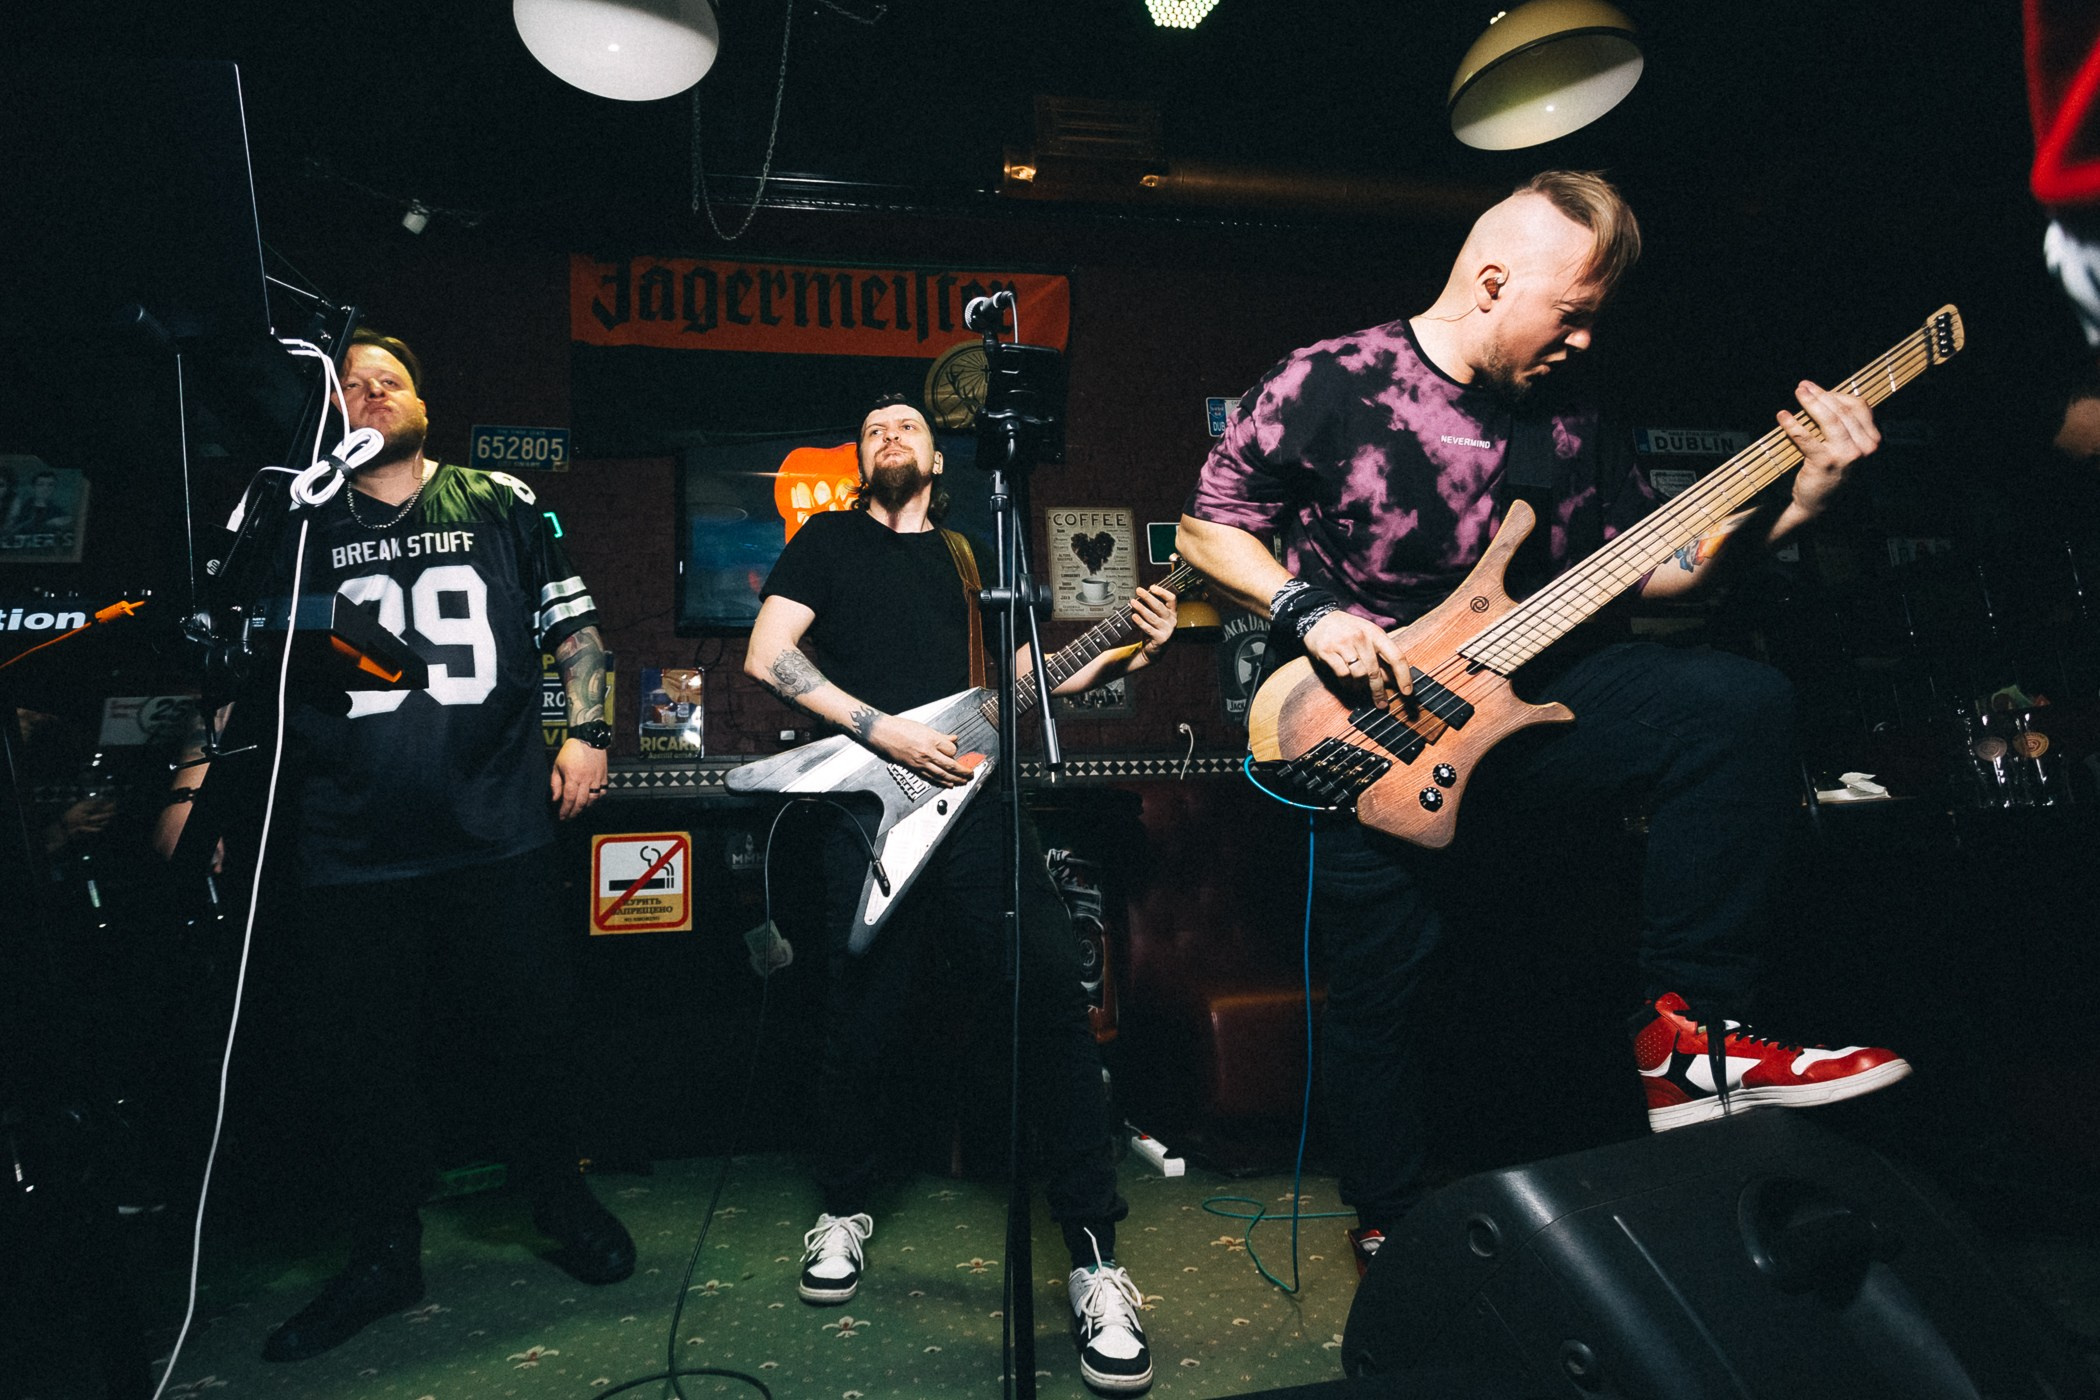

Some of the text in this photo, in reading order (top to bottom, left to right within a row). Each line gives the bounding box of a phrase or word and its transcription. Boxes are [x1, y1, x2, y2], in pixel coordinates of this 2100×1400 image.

[477, 435, 564, 461] 652805
[1440, 435, 1491, 449] NEVERMIND
[1655, 436, 1735, 452] DUBLIN
[1053, 513, 1127, 527] COFFEE
[331, 531, 475, 569] BREAK STUFF
[1222, 617, 1249, 643] JACK
